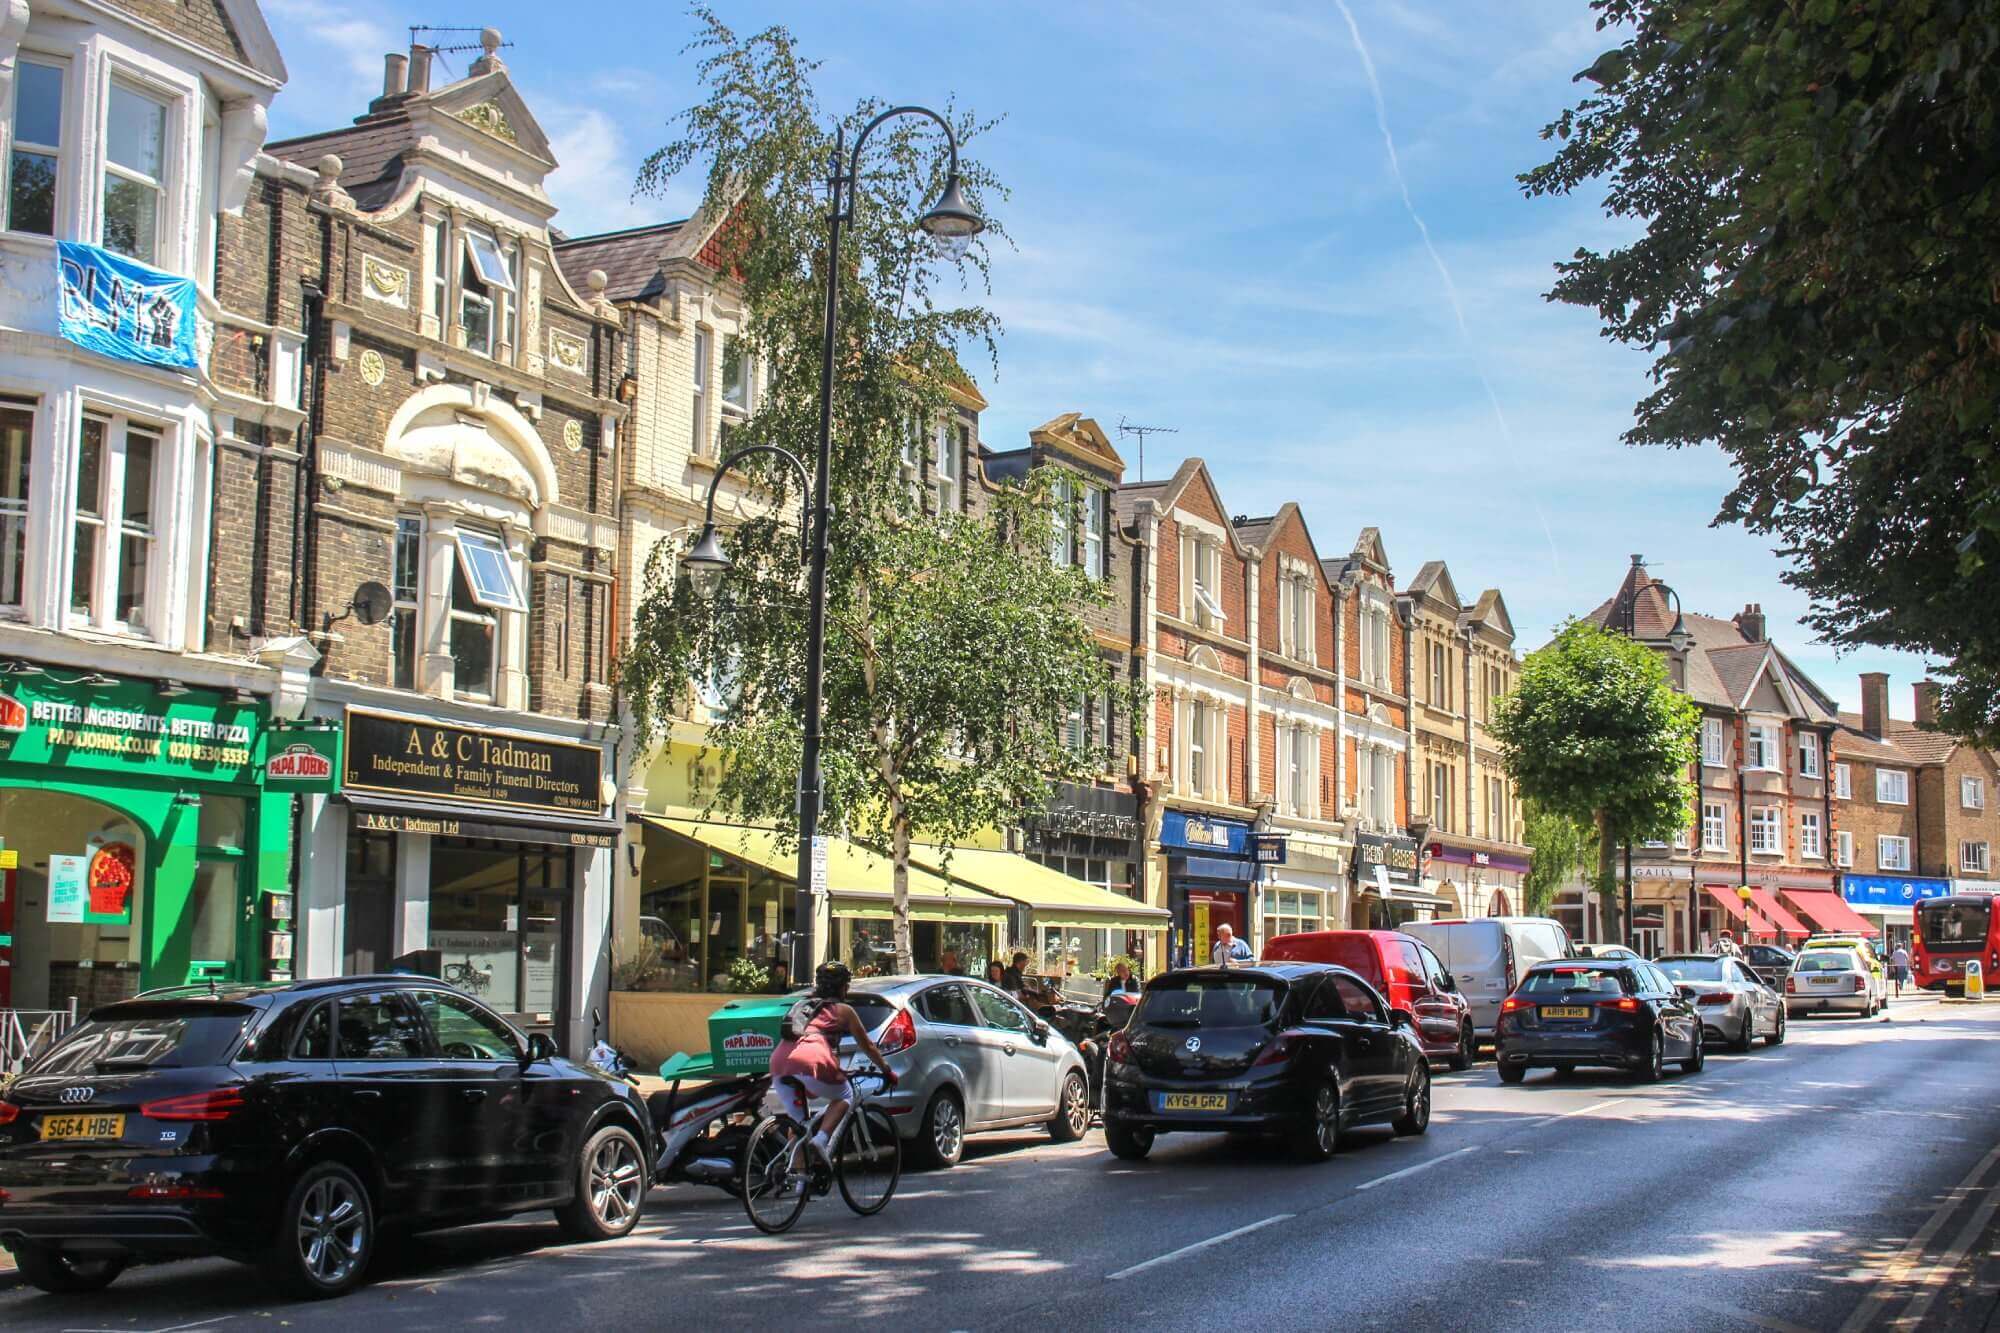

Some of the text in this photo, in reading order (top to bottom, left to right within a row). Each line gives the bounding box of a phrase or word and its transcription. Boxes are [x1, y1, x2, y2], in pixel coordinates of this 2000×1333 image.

[33, 700, 81, 724] BETTER
[171, 718, 215, 738] BETTER
[217, 723, 249, 742] PIZZA
[48, 728, 161, 756] PAPAJOHNS.CO.UK
[169, 742, 191, 758] 020
[407, 727, 552, 772] A & C Tadman
[270, 755, 295, 775] PAPA
[372, 755, 579, 794] Independent & Family Funeral Directors
[454, 783, 491, 799] Established
[368, 813, 459, 834] A & C Tadman Ltd
[1213, 825, 1229, 846] HILL
[1258, 850, 1279, 861] HILL
[725, 1036, 744, 1049] PAPA
[1166, 1095, 1225, 1108] KY64 GRZ
[48, 1118, 118, 1137] SG64 HBE
